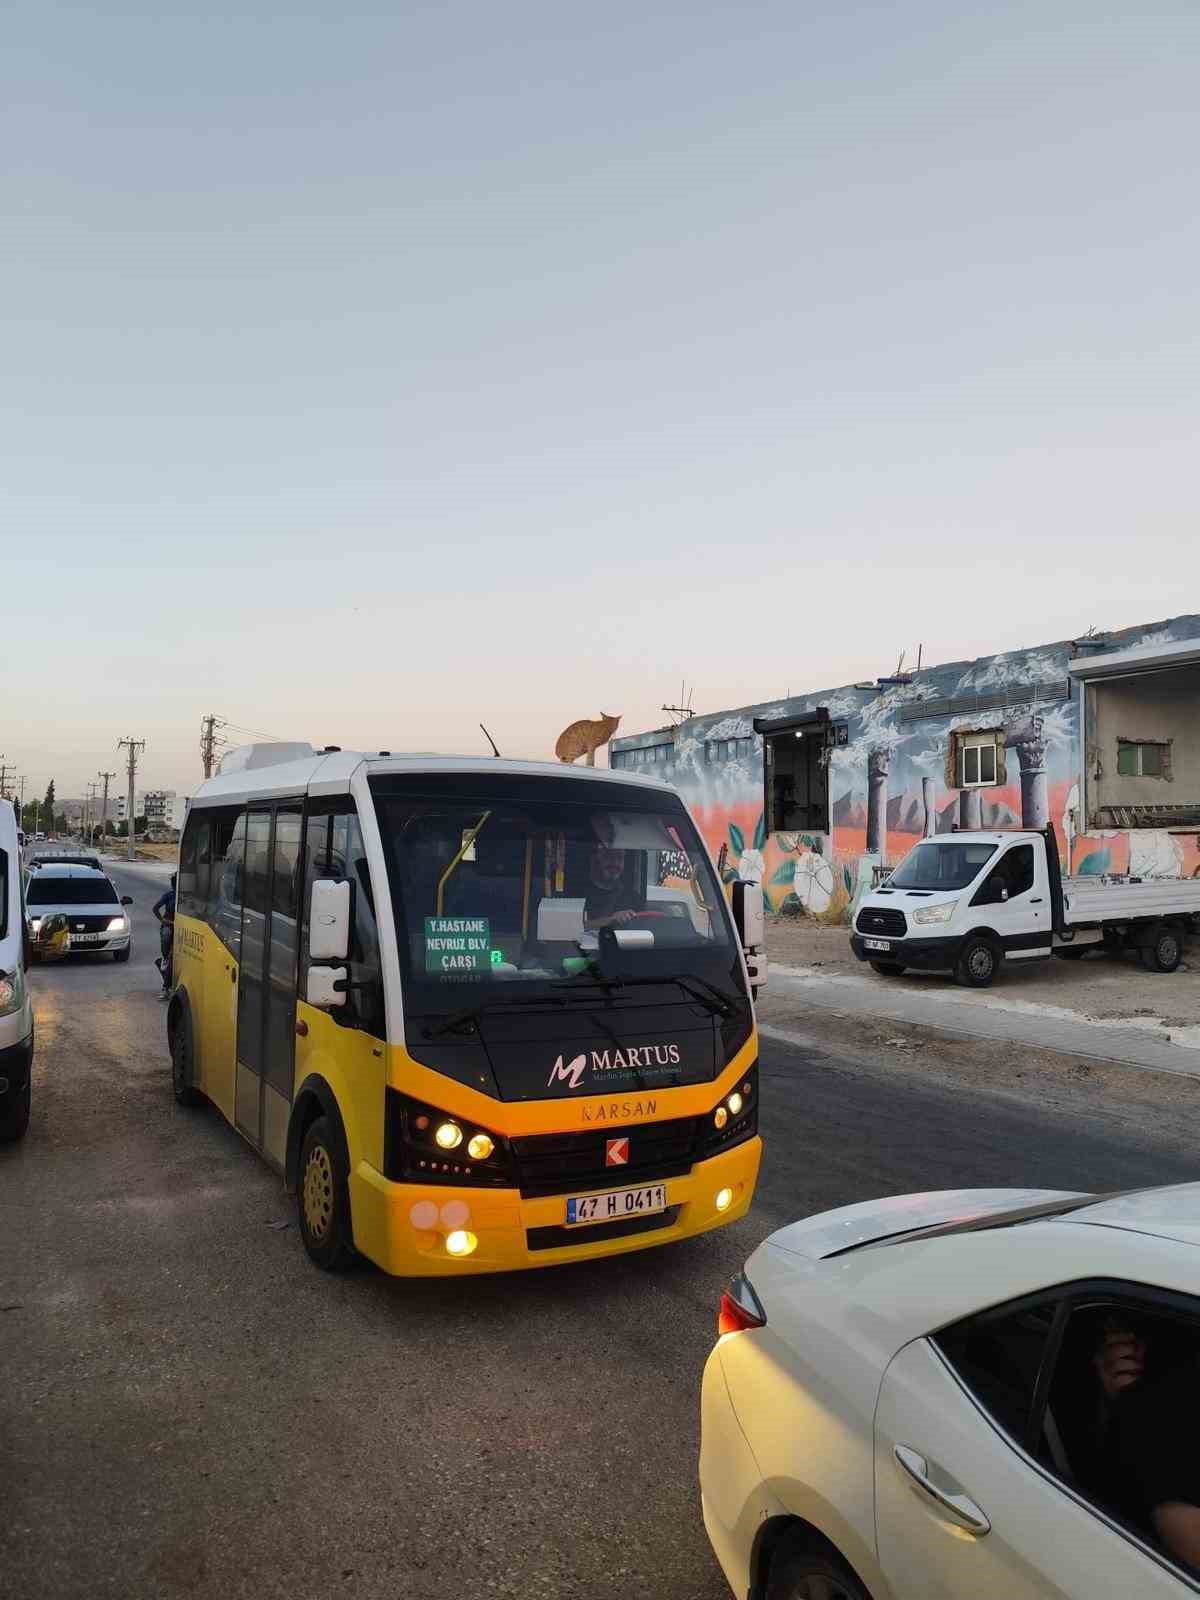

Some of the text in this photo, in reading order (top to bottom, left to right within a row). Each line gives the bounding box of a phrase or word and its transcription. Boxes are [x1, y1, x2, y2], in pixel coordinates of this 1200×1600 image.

[427, 938, 489, 951] NEVRUZ BLV.
[441, 955, 477, 971] ÇARŞI
[590, 1044, 681, 1071] MARTUS
[582, 1100, 658, 1120] KARSAN
[579, 1199, 599, 1218] 47
[607, 1195, 617, 1215] H
